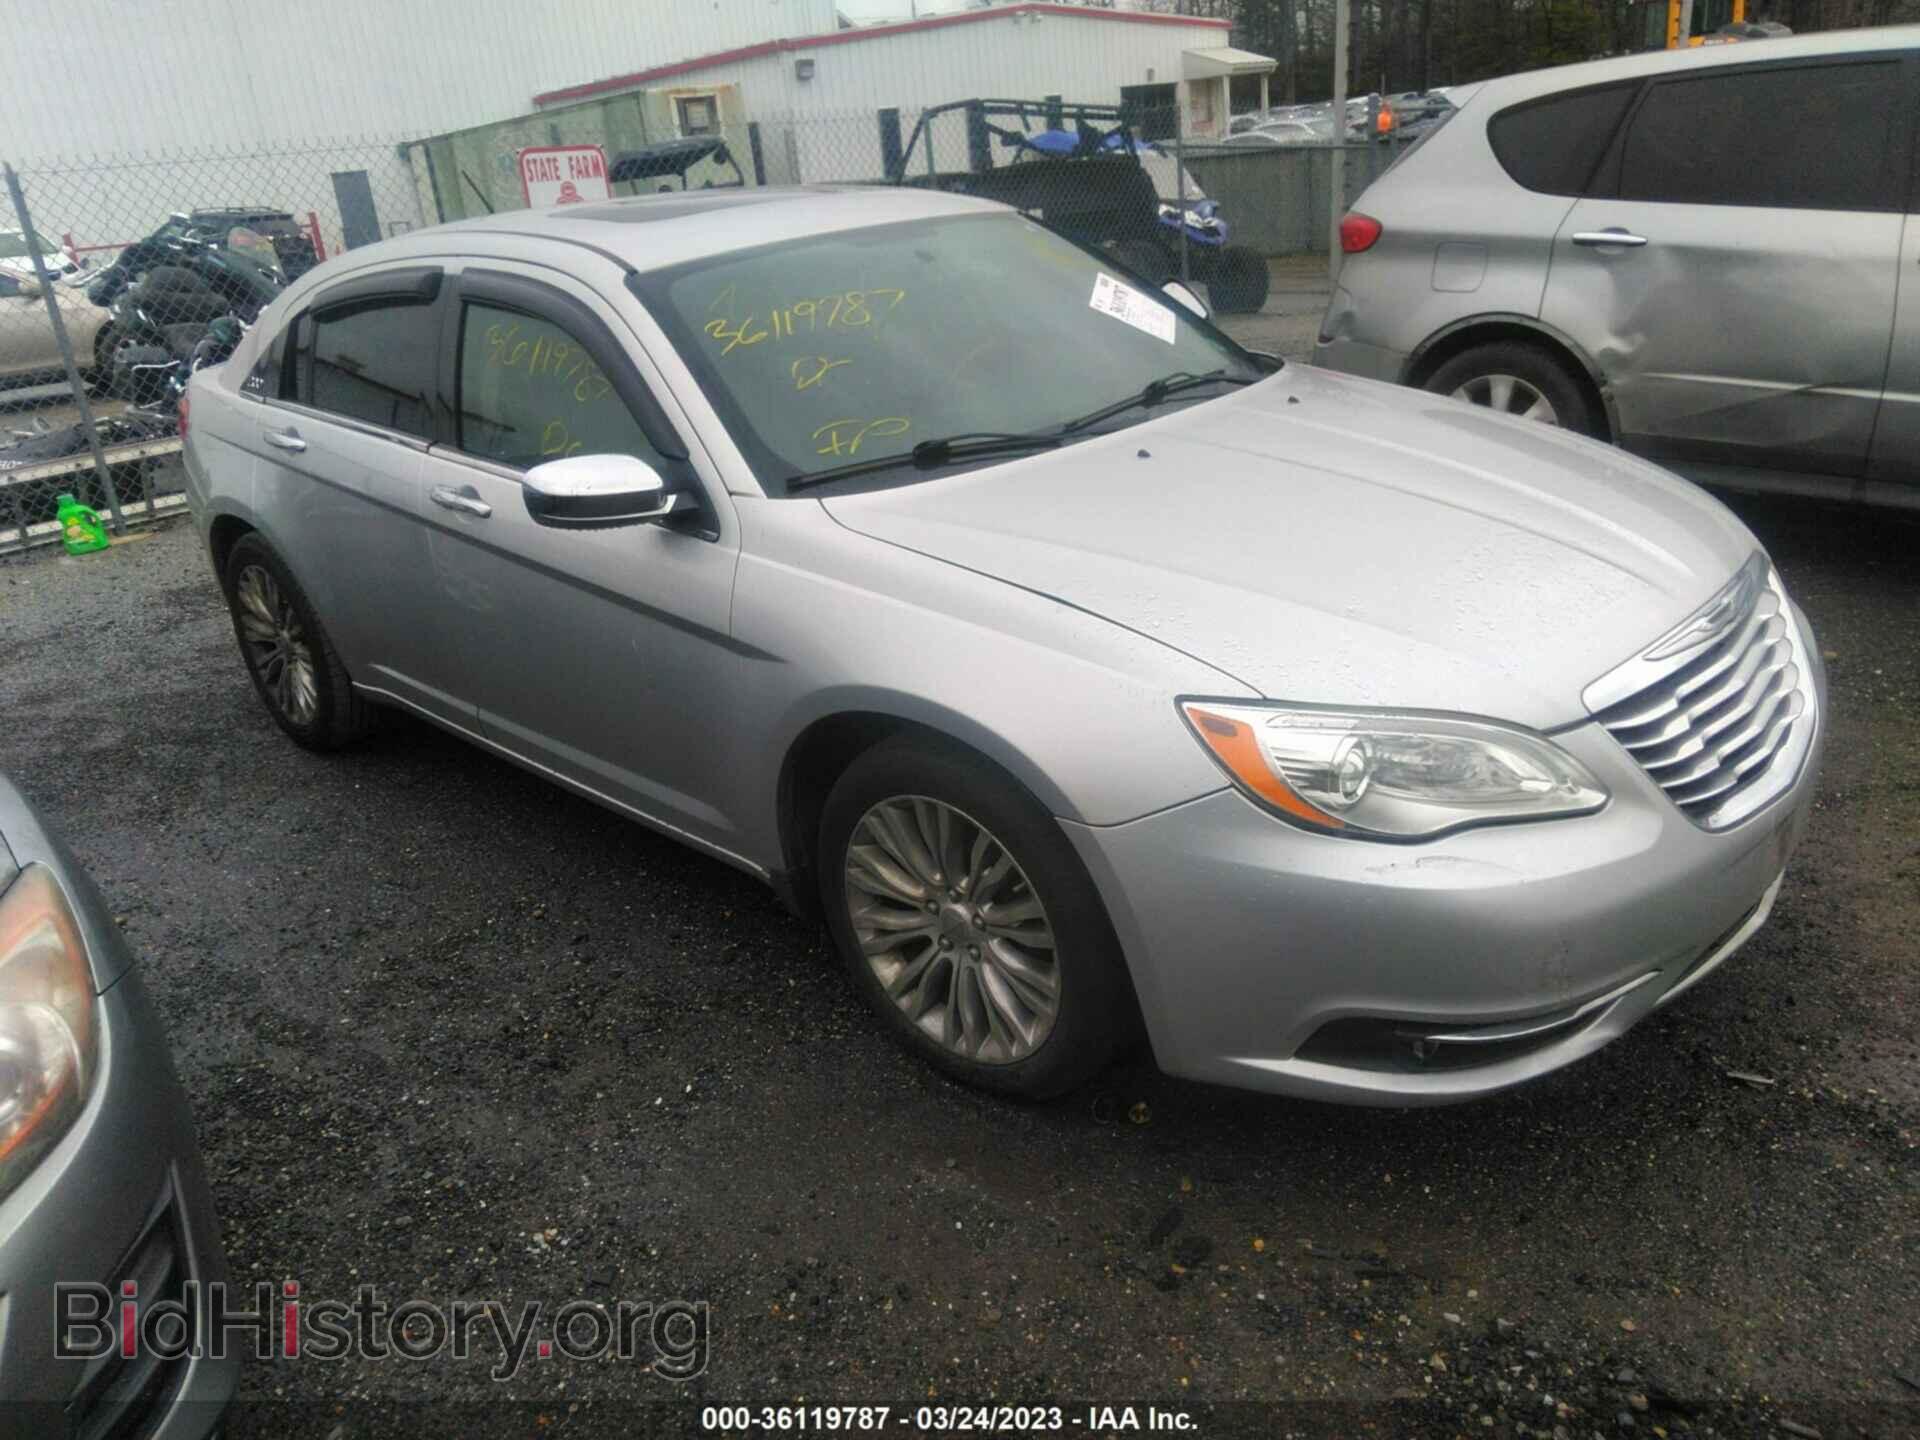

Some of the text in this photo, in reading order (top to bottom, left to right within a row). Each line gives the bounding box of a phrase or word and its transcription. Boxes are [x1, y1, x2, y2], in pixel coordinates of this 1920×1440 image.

[527, 155, 601, 181] STATE FARM
[704, 289, 905, 356] 36119787
